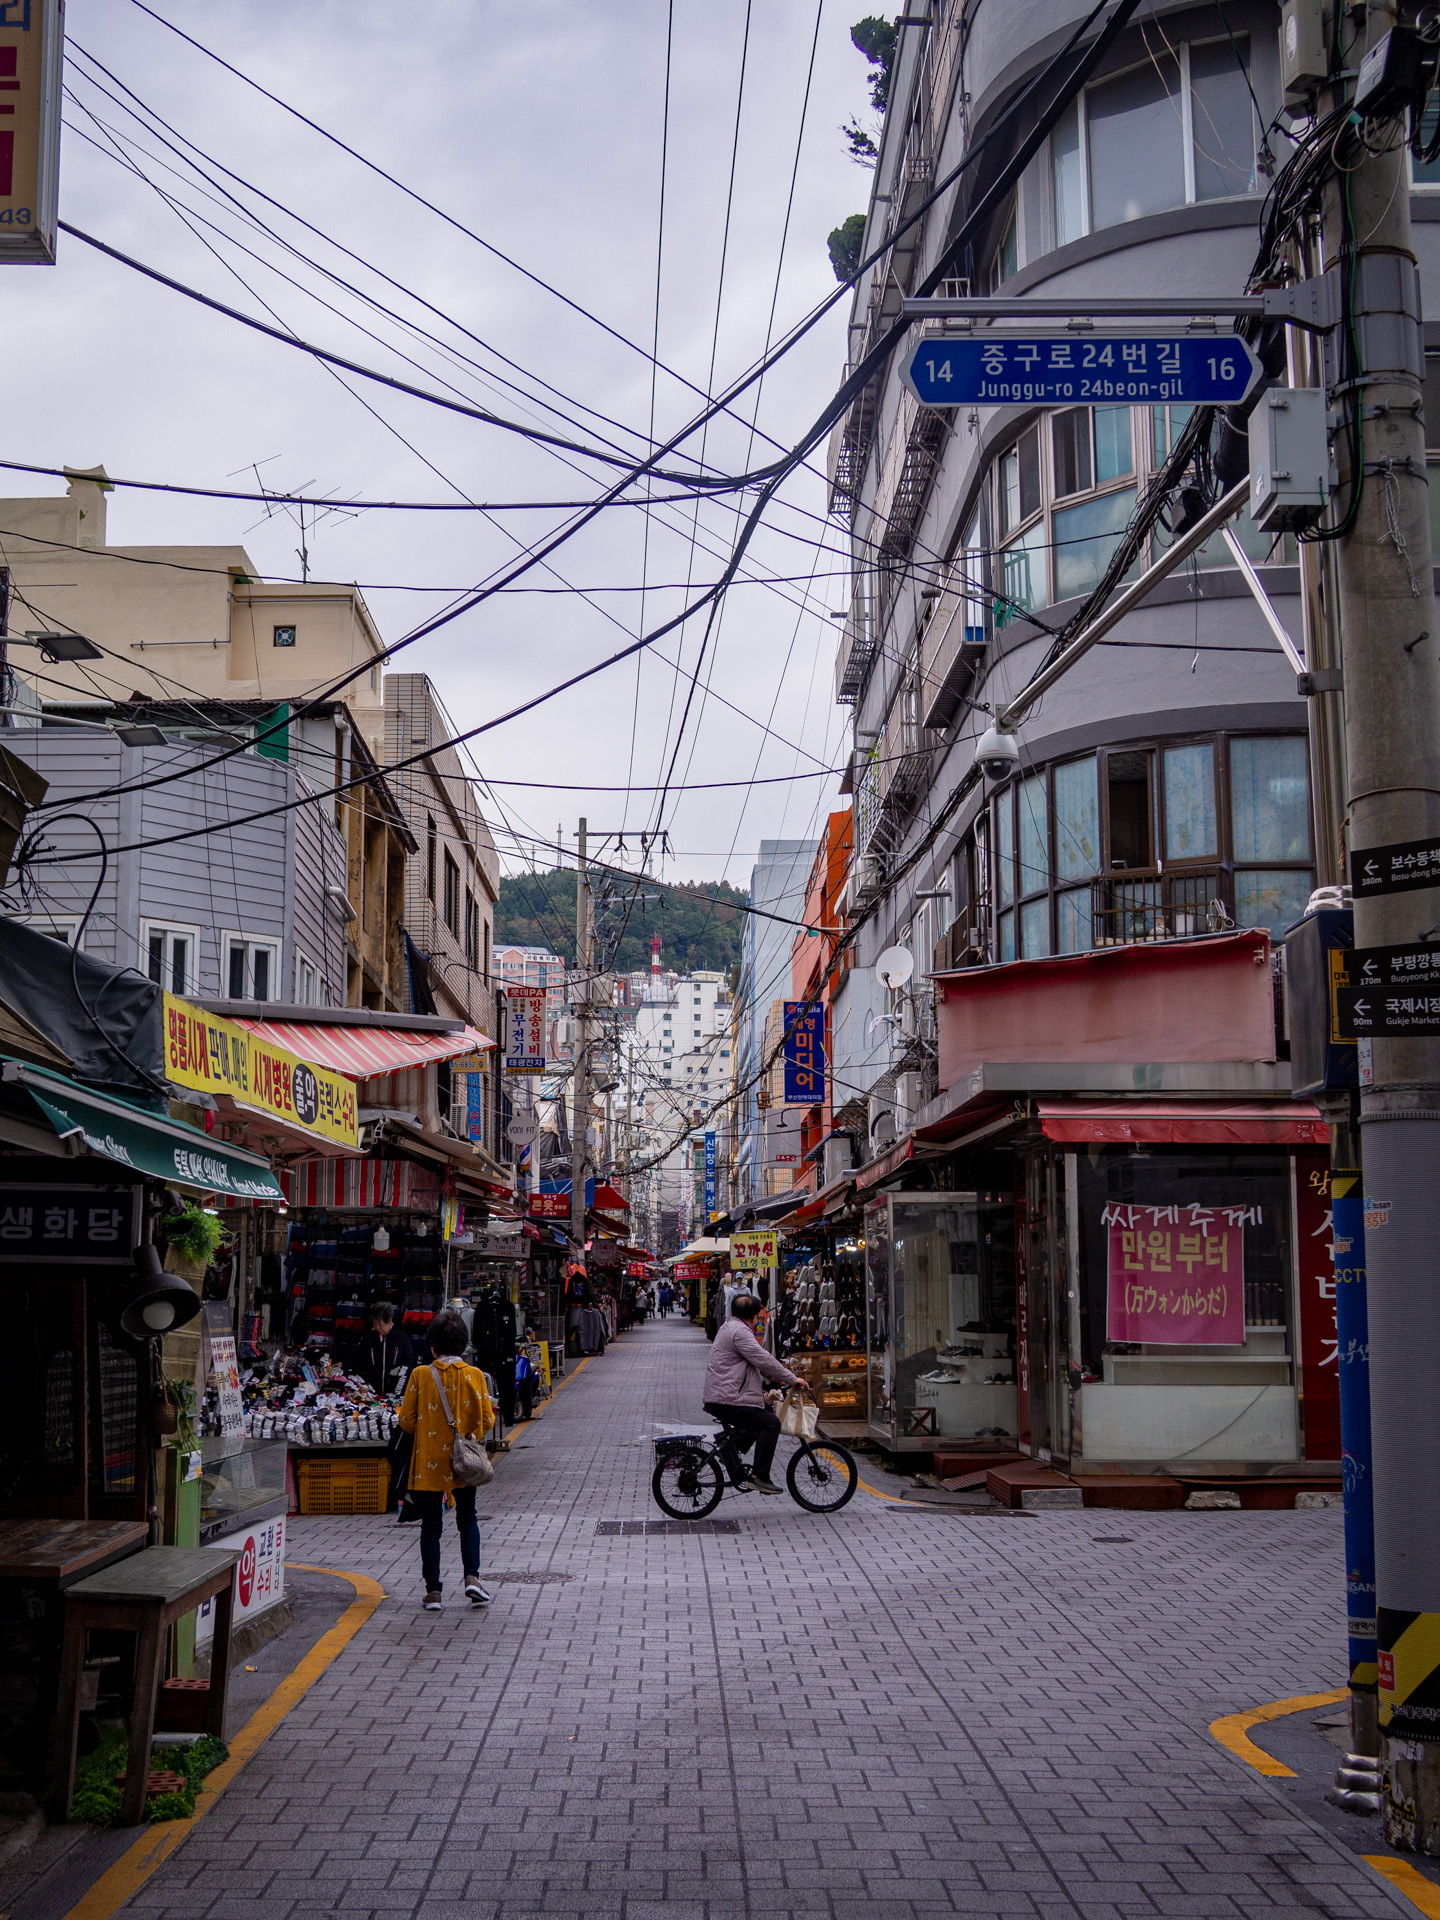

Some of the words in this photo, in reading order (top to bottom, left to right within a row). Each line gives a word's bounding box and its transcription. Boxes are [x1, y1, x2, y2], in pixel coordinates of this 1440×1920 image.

[925, 360, 953, 383] 14
[1206, 358, 1236, 381] 16
[977, 380, 1074, 400] Junggu-ro
[1080, 378, 1184, 399] 24beon-gil
[1361, 876, 1383, 886] 380m
[1391, 867, 1431, 881] Bosu-dong
[1360, 977, 1382, 986] 170m
[1391, 973, 1430, 983] Bupyeong
[528, 999, 542, 1057] 방송설비
[1353, 1017, 1373, 1026] 90m
[1386, 1016, 1410, 1026] Gukje
[1411, 1016, 1440, 1025] Market
[512, 1014, 526, 1057] 무전기
[168, 1007, 211, 1079] 명품시계
[253, 1049, 292, 1112] 시계병원
[342, 1090, 355, 1136] 수리
[508, 1059, 542, 1067] 태광전자
[796, 1033, 814, 1091] 미디어
[470, 1110, 481, 1136] 수리
[0, 1206, 124, 1241] 생화당
[259, 1526, 274, 1558] 교환
[276, 1522, 283, 1548] 금
[242, 1547, 255, 1597] 약
[257, 1565, 272, 1601] 수리
